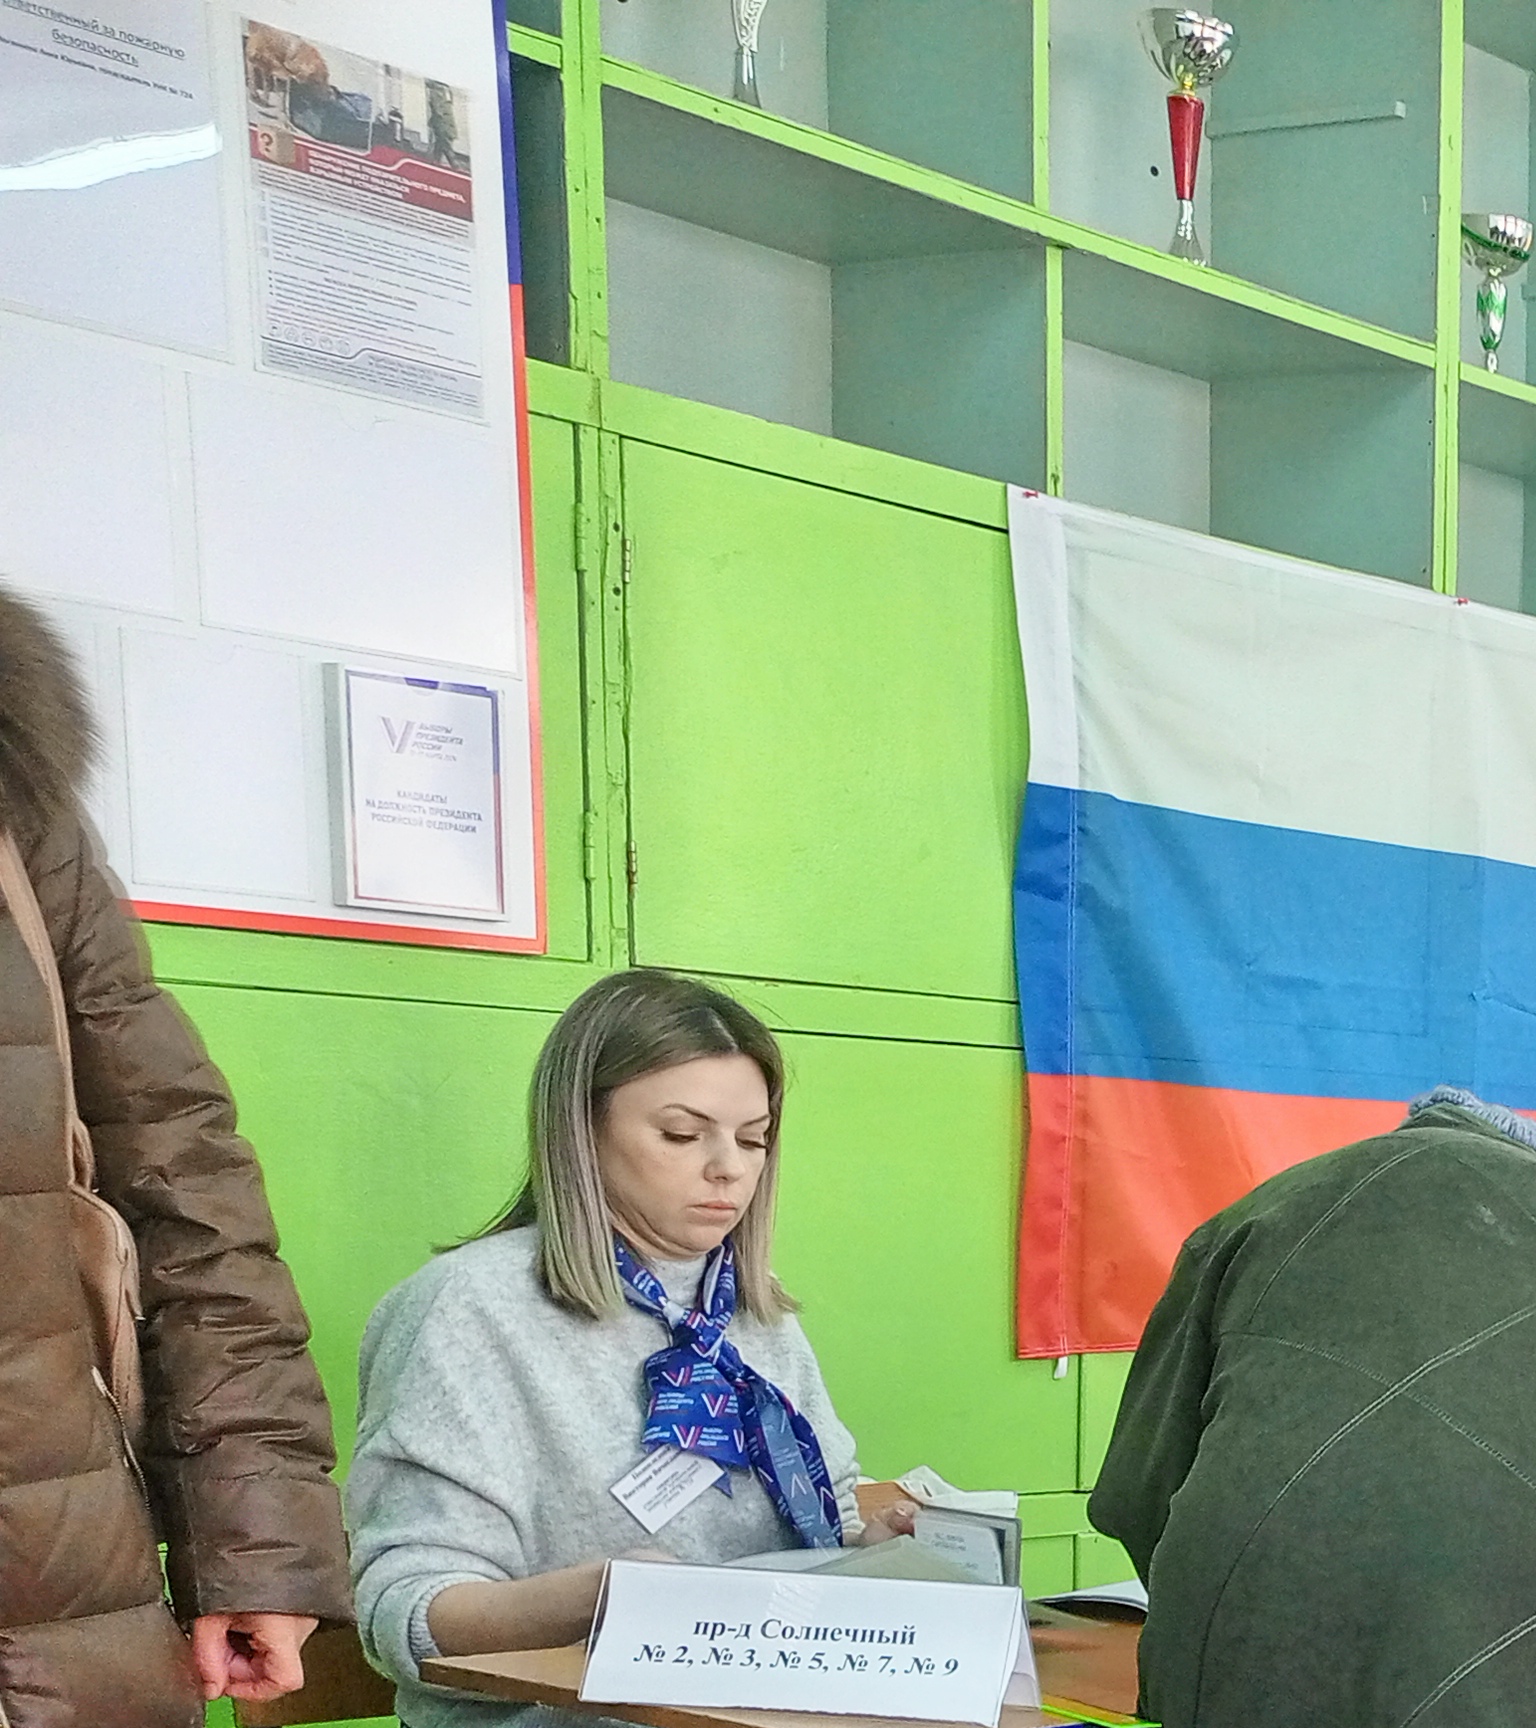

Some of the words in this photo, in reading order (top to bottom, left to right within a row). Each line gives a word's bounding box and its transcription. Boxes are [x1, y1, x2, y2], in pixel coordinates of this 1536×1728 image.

[52, 28, 139, 65] безопасность
[426, 819, 477, 833] ФЕДЕРАЦИИ
[429, 807, 483, 822] ПРЕЗИДЕНТА
[693, 1621, 752, 1641] пр-д
[760, 1618, 917, 1645] Солнечный
[633, 1644, 666, 1663] №
[672, 1645, 694, 1668] 2,
[702, 1647, 734, 1666] №
[739, 1648, 762, 1672] 3,
[769, 1650, 802, 1669] №
[808, 1652, 829, 1673] 5,
[837, 1653, 869, 1672] №
[877, 1655, 897, 1677] 7,
[904, 1656, 936, 1675] №
[941, 1658, 960, 1676] 9
